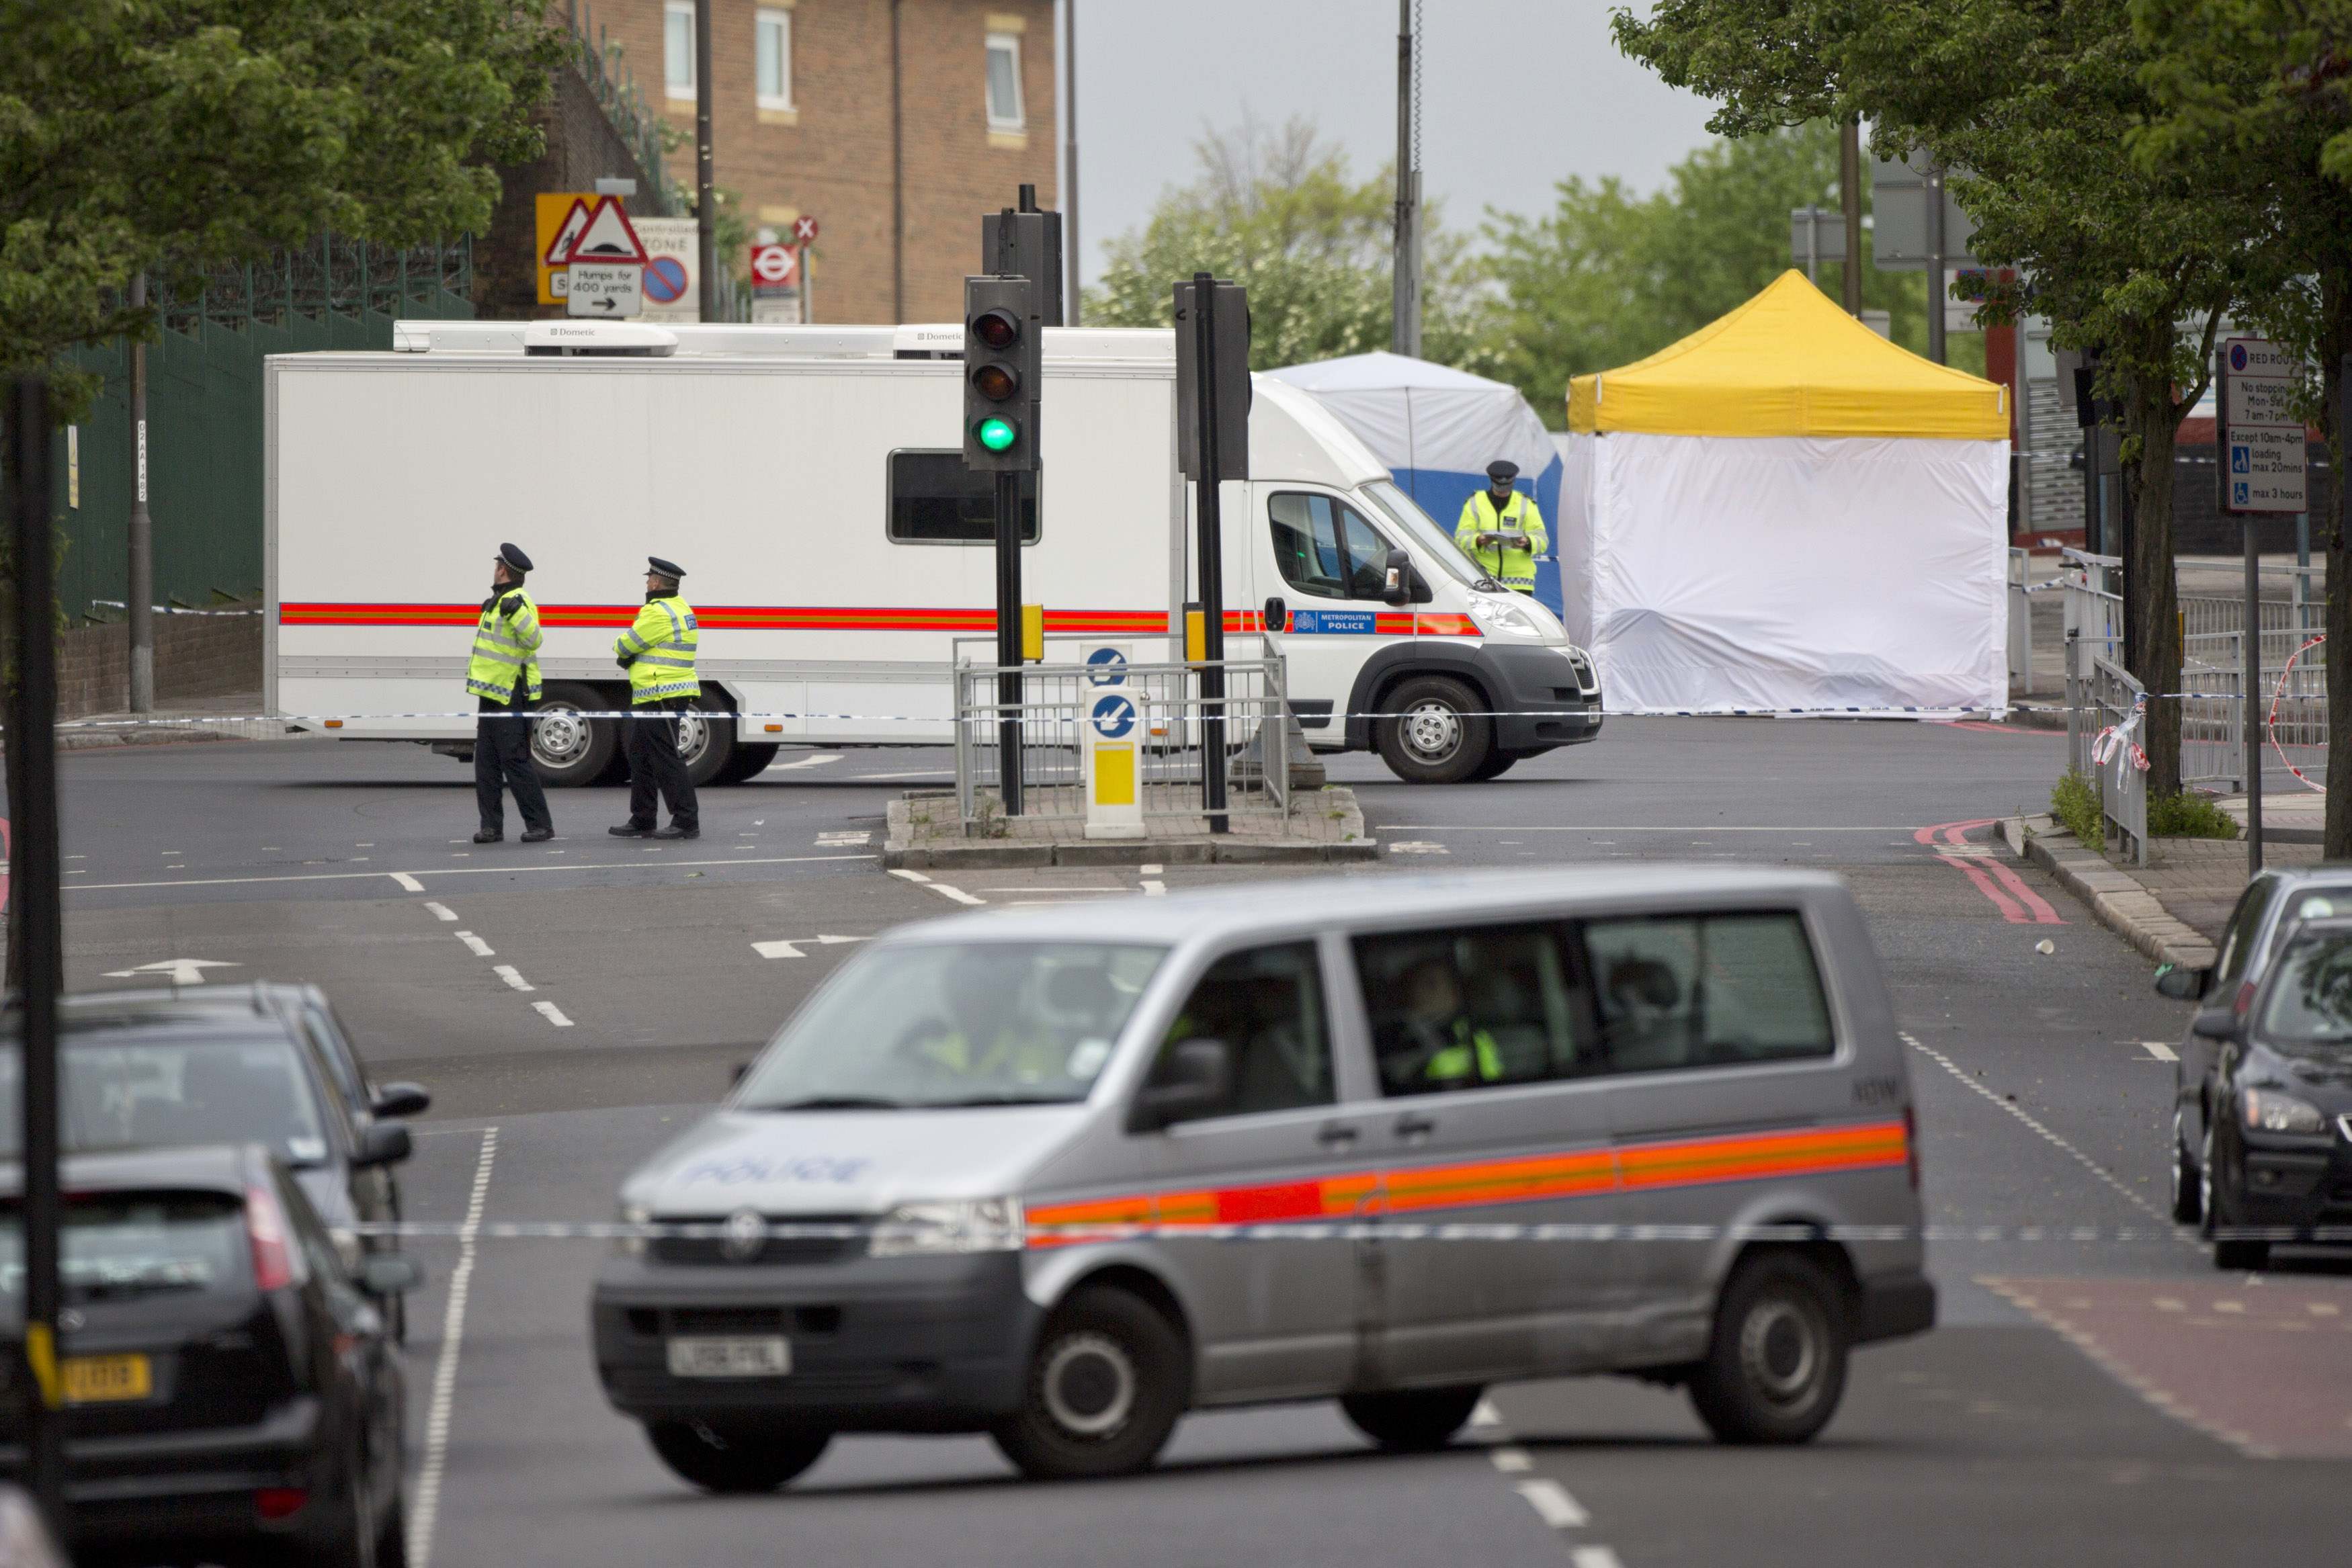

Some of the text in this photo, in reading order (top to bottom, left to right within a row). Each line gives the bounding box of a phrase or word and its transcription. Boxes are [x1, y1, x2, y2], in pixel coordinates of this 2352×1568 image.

[578, 270, 632, 281] Humps for
[573, 281, 632, 294] 400 yards
[559, 328, 595, 336] Dometic
[2249, 353, 2268, 363] RED
[2241, 382, 2286, 394] No stoppin
[2230, 432, 2258, 444] Except
[2252, 449, 2281, 461] loading
[2253, 464, 2269, 472] max
[2253, 488, 2303, 500] max 3 hours
